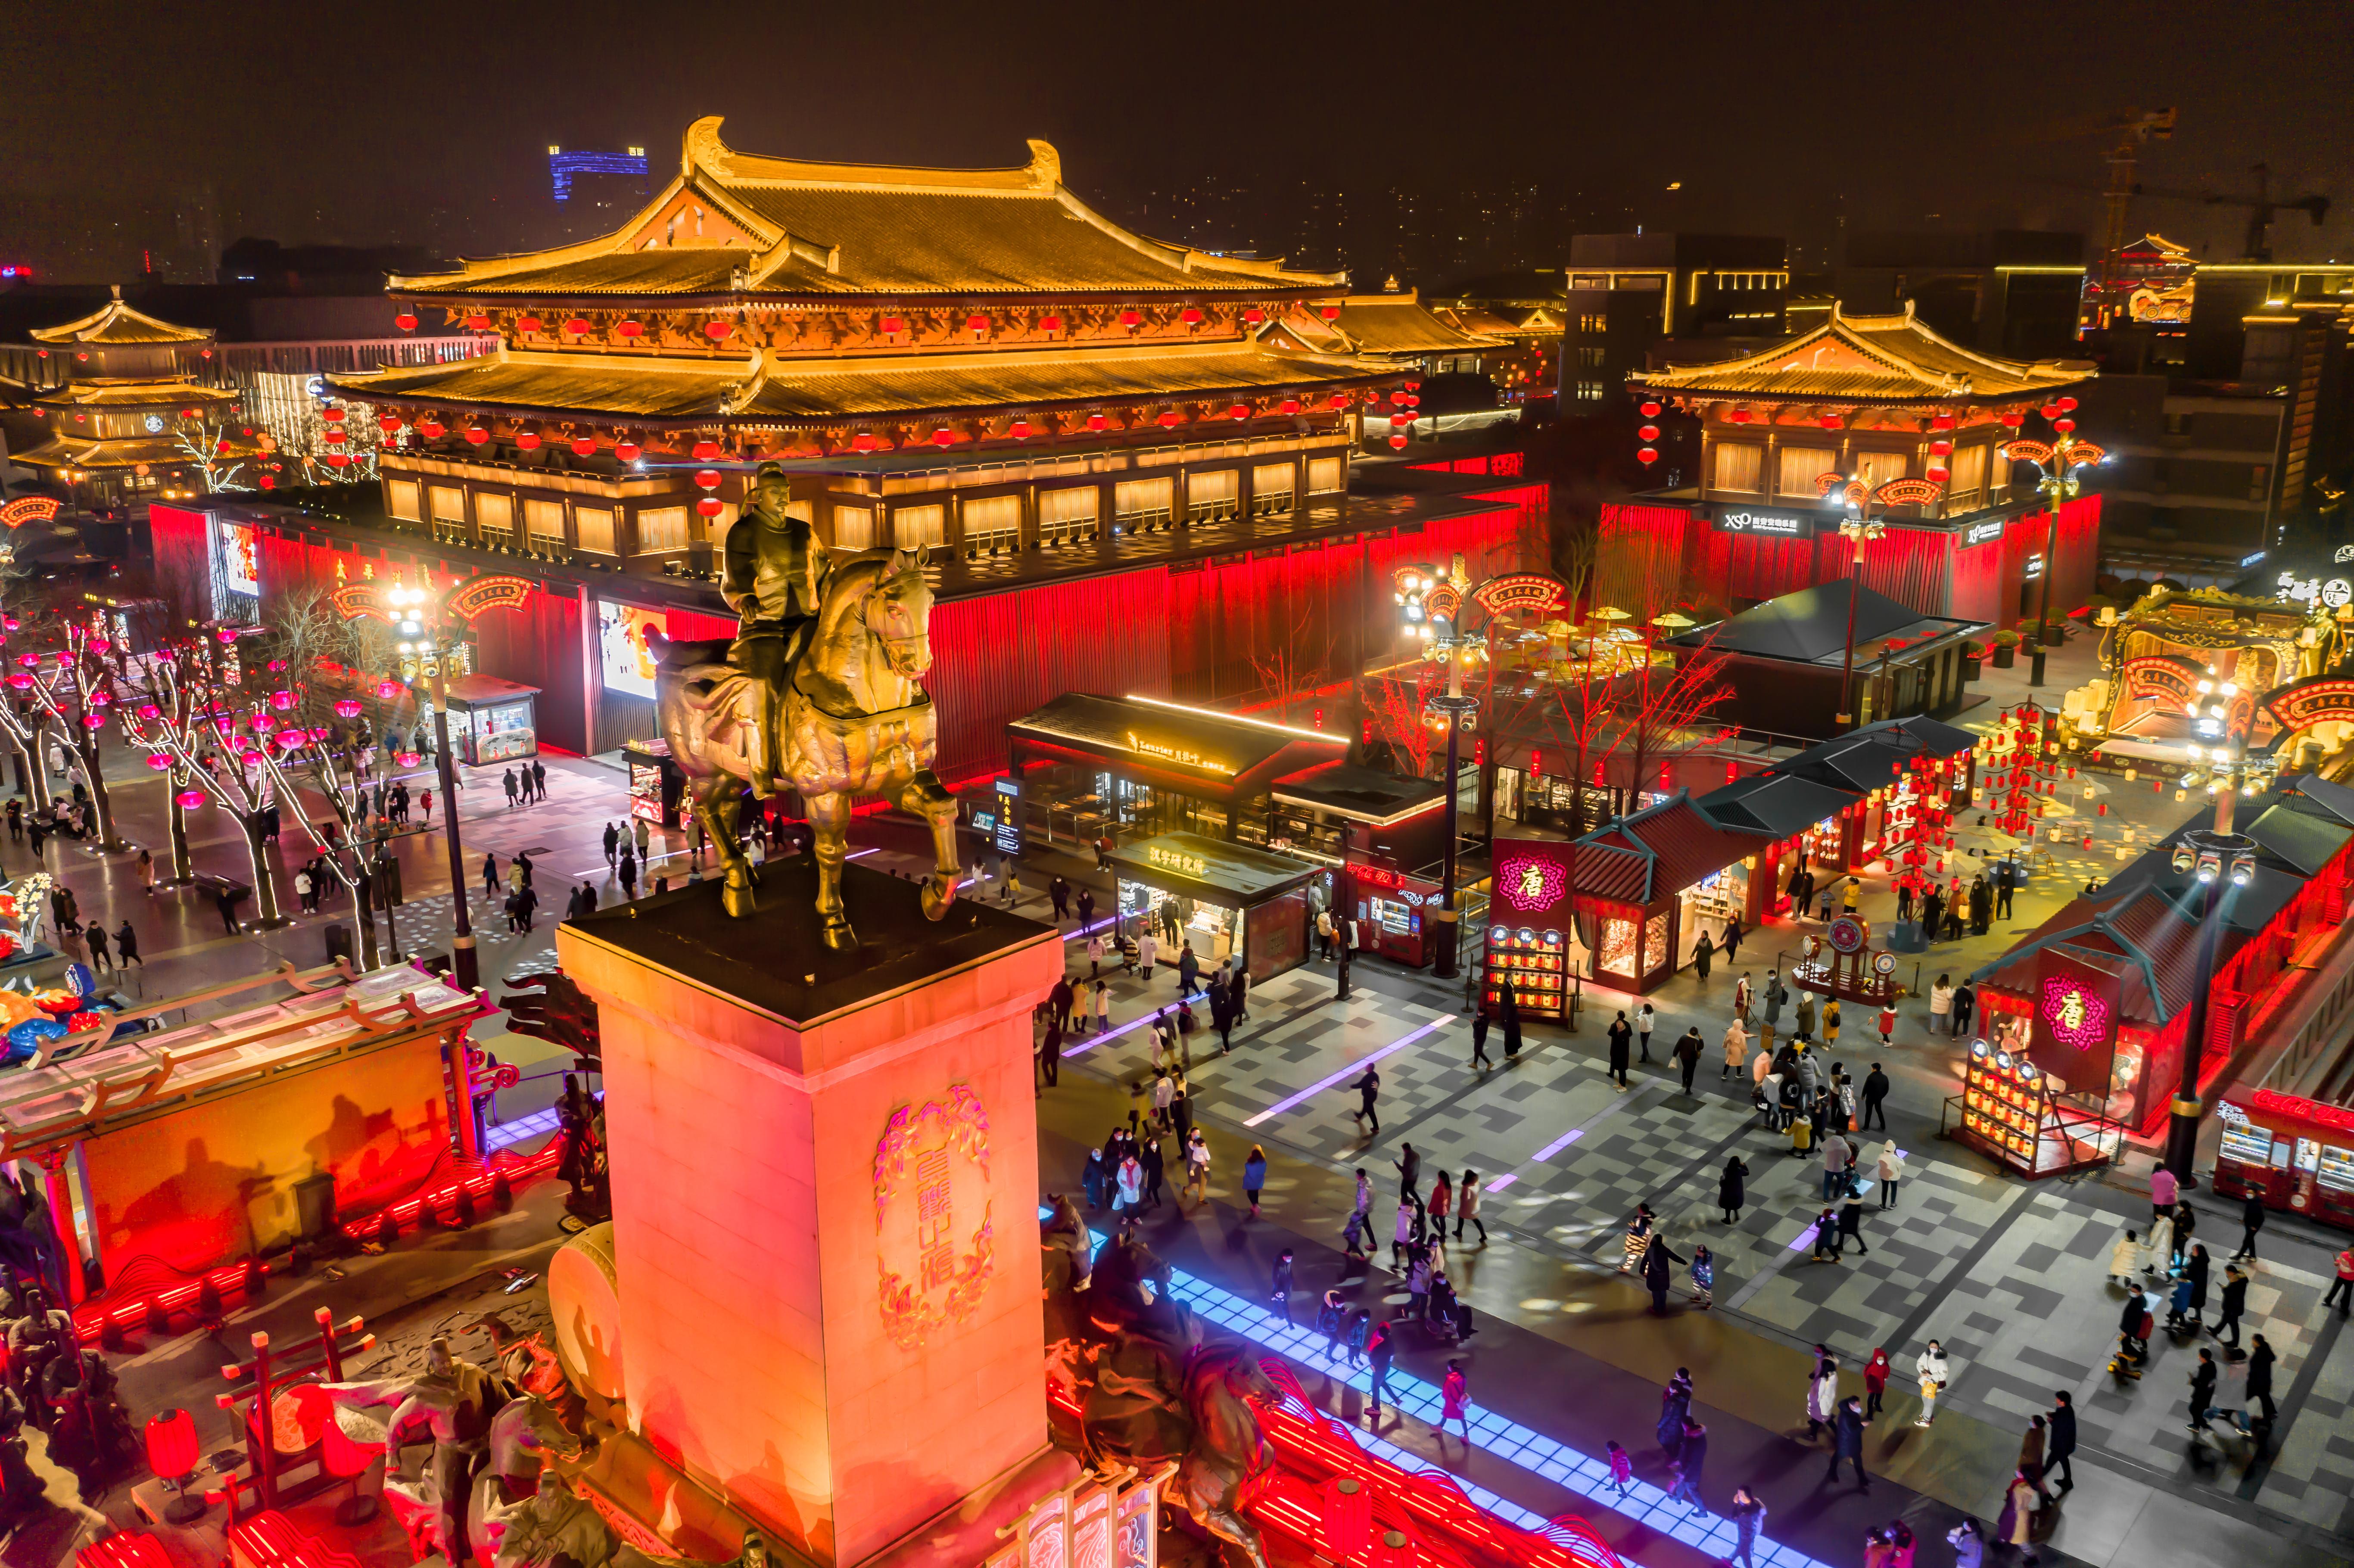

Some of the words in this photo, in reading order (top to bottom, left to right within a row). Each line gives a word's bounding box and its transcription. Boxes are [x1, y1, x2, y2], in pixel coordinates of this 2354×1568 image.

[1725, 513, 1751, 529] XSO
[1499, 587, 1541, 600] 大唐不夜城
[2305, 696, 2354, 711] 大唐不夜
[1139, 740, 1173, 755] Laurier
[1149, 846, 1204, 874] 汉字研究所
[1517, 865, 1543, 897] 唐
[2055, 990, 2086, 1030] 唐
[2253, 1089, 2314, 1119] Coca-Cola
